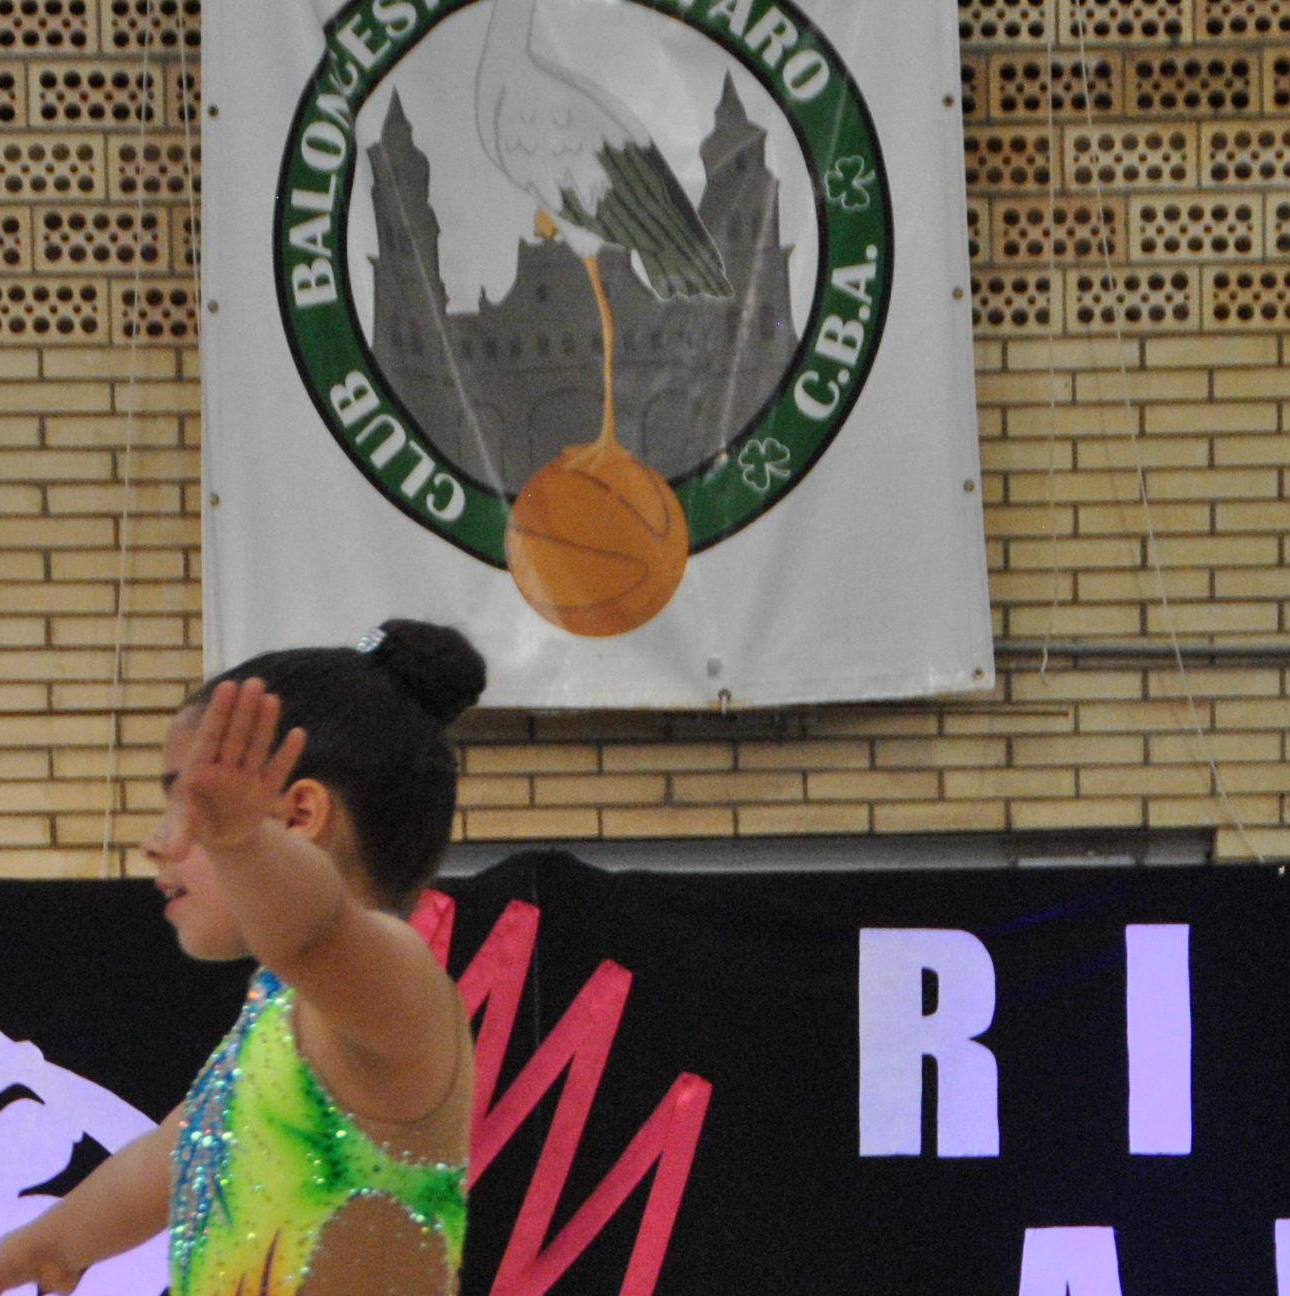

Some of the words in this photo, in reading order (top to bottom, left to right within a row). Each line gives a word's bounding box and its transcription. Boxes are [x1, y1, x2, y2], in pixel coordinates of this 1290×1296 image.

[289, 0, 441, 307] BALONCES
[794, 244, 878, 420] C.B.A.
[330, 369, 466, 522] CLUB
